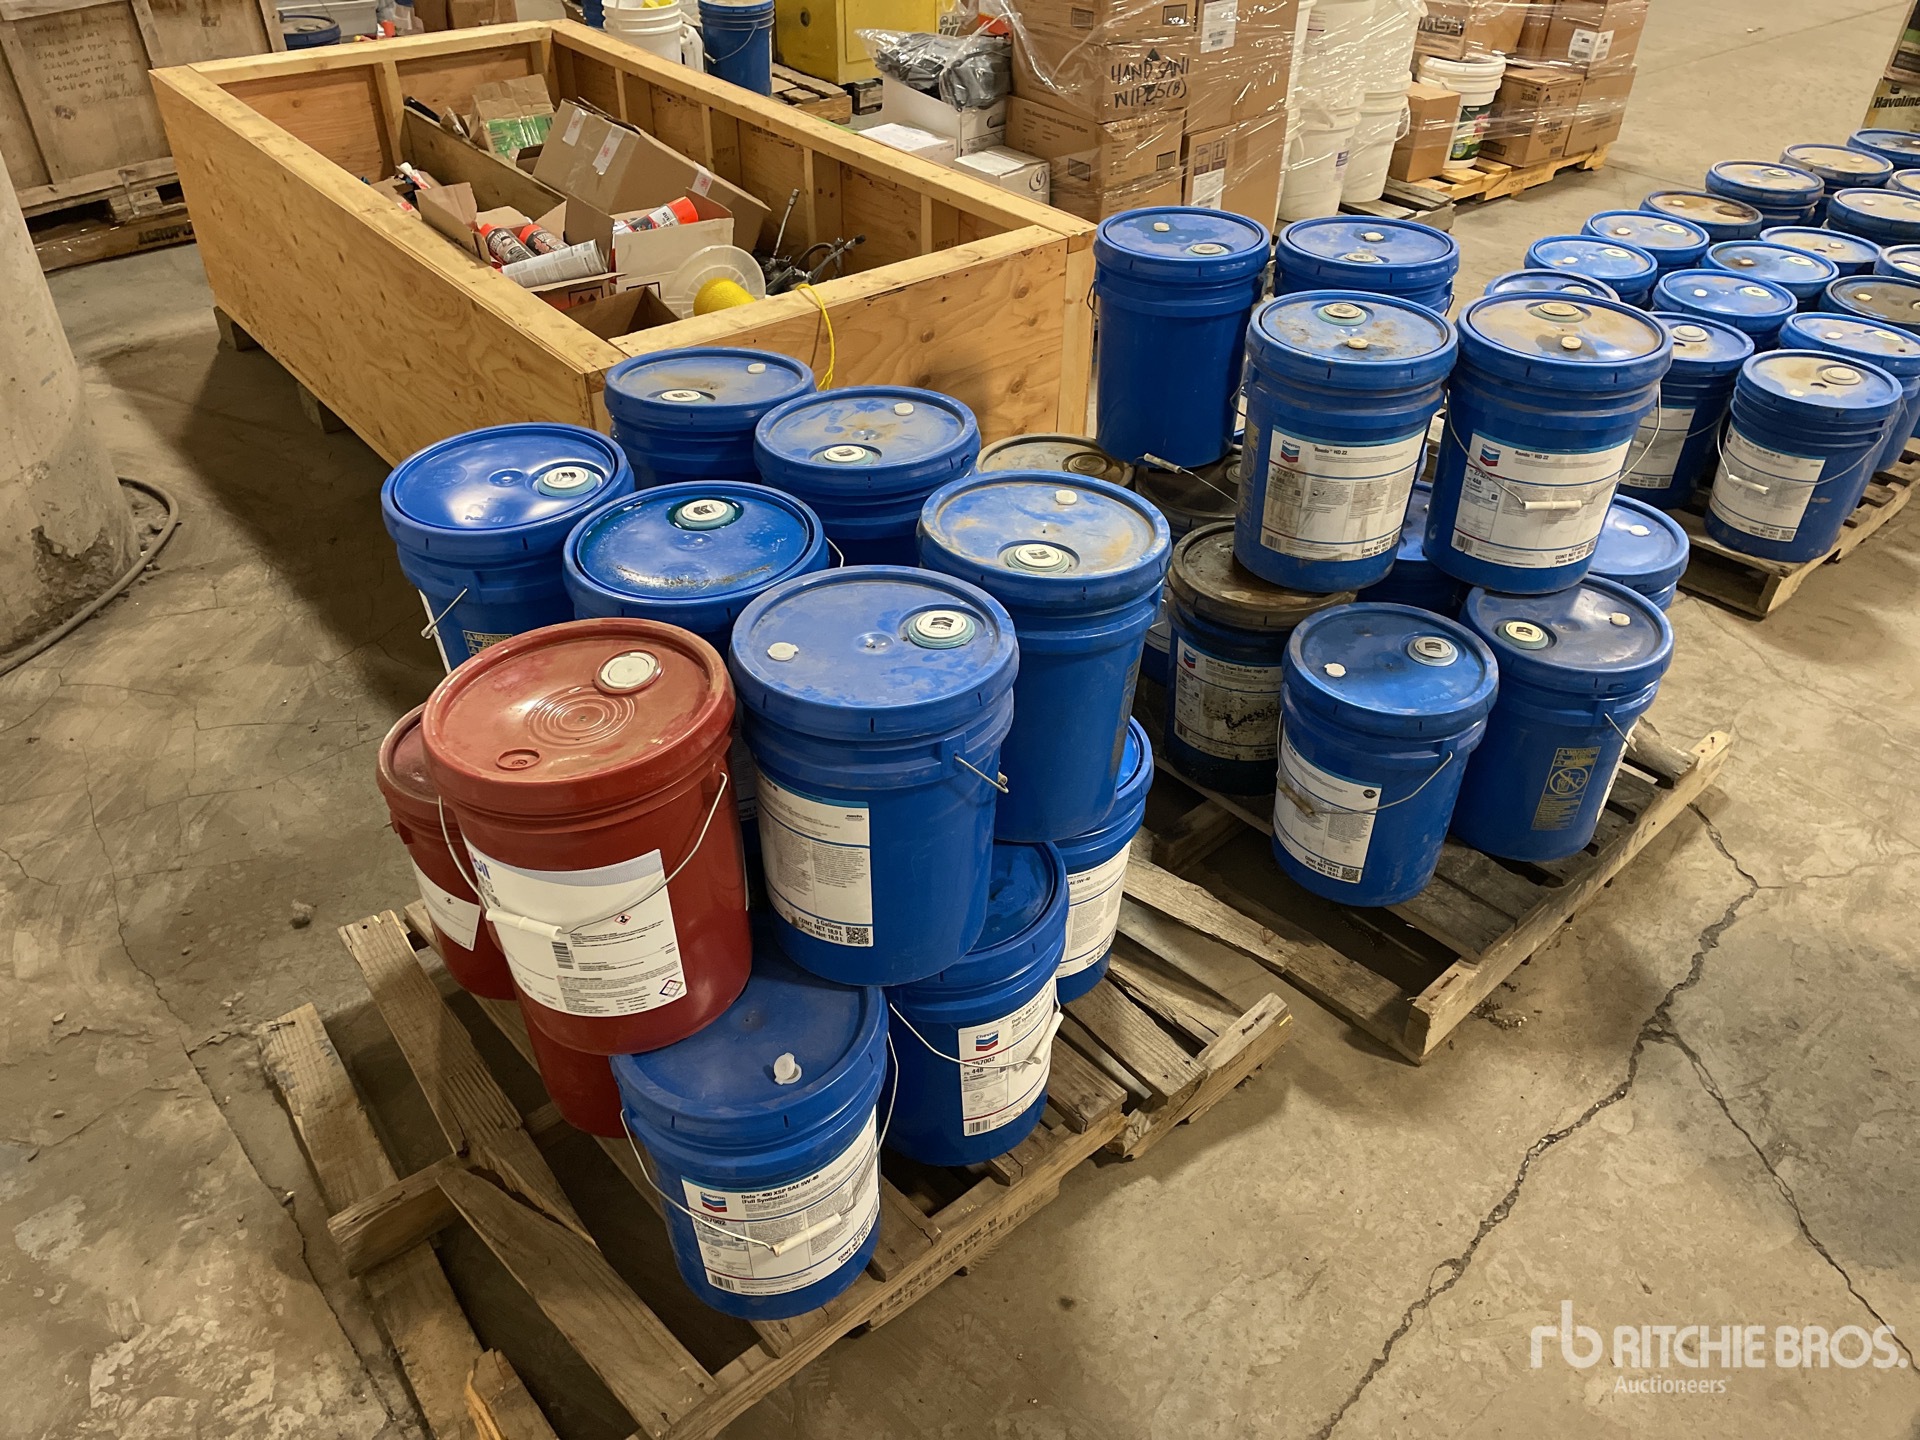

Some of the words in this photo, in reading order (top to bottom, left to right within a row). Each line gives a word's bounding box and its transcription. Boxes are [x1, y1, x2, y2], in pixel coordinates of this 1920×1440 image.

[1111, 60, 1153, 85] HAND
[1873, 95, 1920, 109] Havoline
[1282, 439, 1301, 450] Chevron
[820, 920, 843, 930] Gallons
[975, 1030, 999, 1040] Chevron
[787, 1183, 801, 1192] SAE
[800, 1174, 819, 1187] 5W-40
